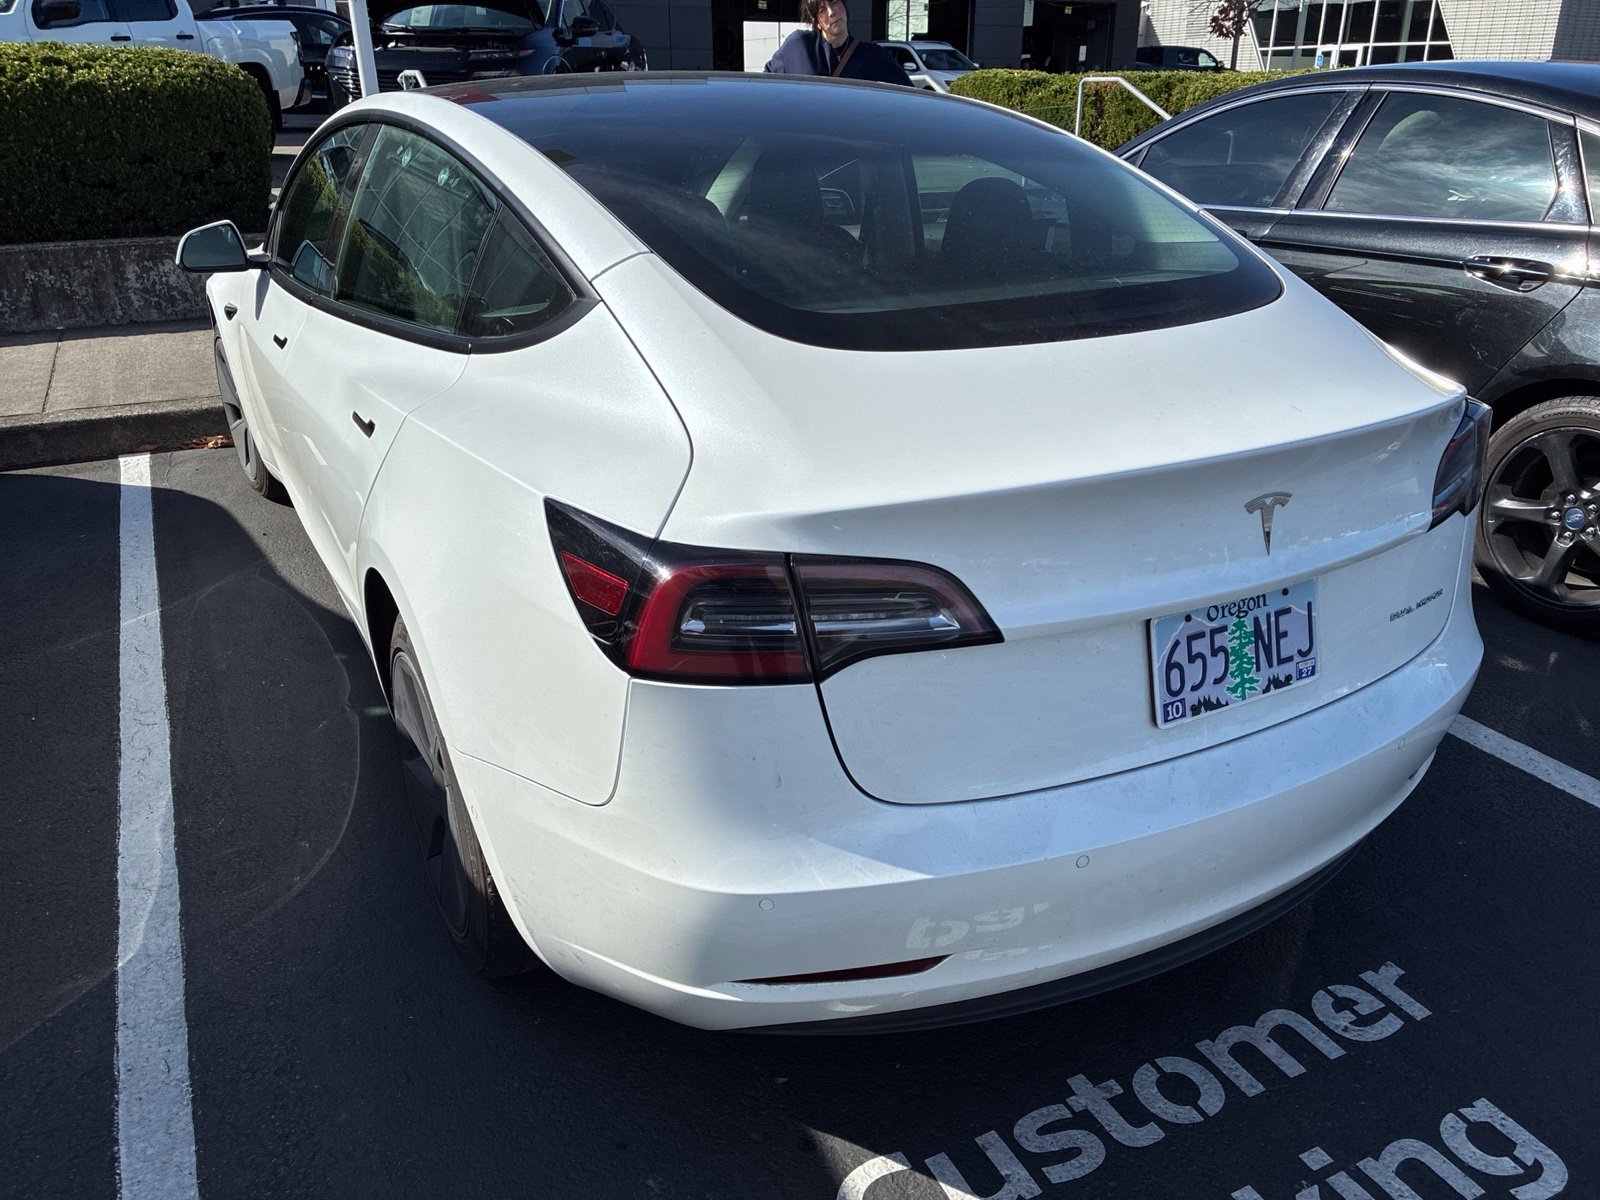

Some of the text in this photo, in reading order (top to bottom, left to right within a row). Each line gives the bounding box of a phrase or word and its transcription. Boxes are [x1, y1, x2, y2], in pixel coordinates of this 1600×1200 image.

[1206, 593, 1268, 619] Oregon
[1165, 601, 1314, 698] 655 NEJ
[1301, 666, 1313, 678] 27
[1166, 701, 1183, 720] 10
